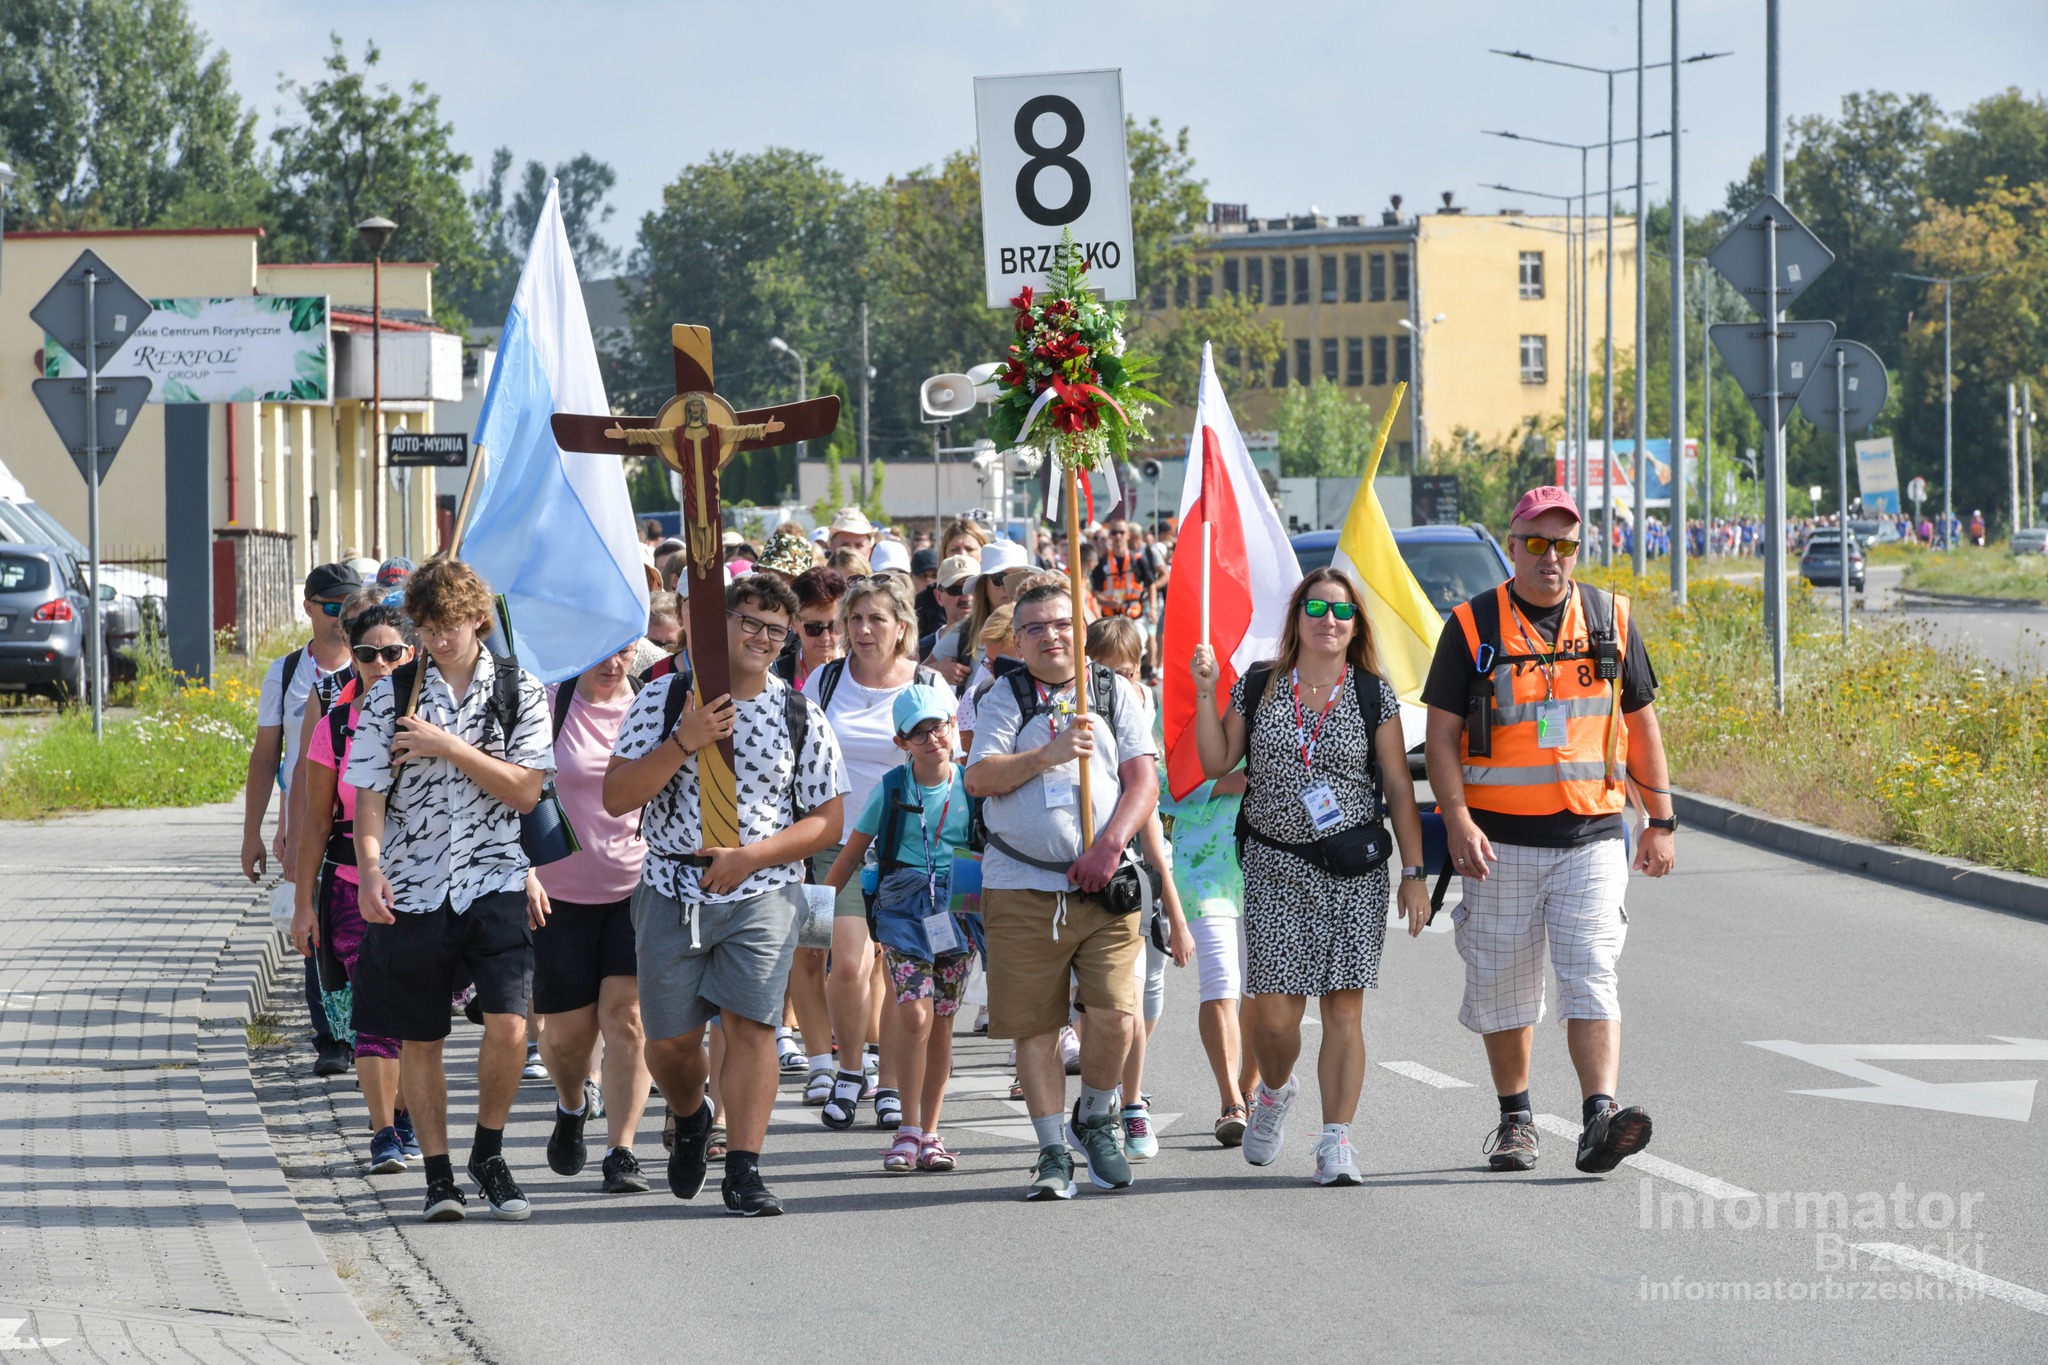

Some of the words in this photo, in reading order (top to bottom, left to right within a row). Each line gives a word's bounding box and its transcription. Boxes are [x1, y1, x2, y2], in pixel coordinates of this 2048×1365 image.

[1014, 94, 1091, 226] 8
[134, 326, 158, 337] skie
[161, 326, 209, 337] Centrum
[213, 325, 282, 338] Florystyczne
[168, 370, 210, 380] GROUP
[391, 437, 464, 452] AUTO-MYJNIA
[1577, 665, 1593, 688] 8
